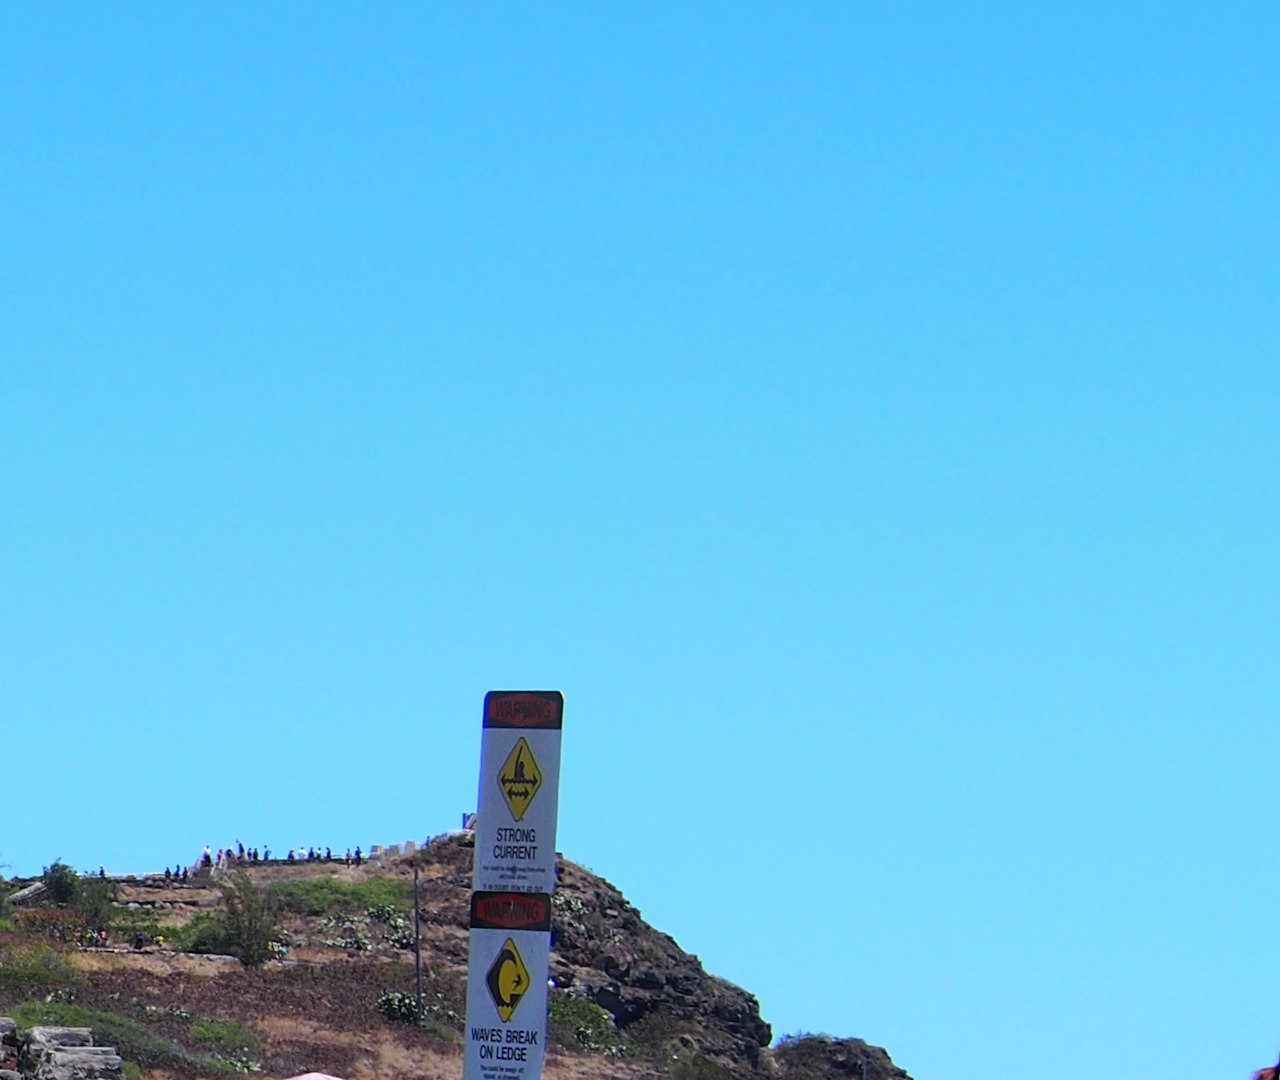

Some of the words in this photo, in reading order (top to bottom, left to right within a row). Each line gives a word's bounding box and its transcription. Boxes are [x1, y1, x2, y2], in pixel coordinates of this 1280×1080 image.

[496, 828, 536, 842] STRONG
[493, 845, 538, 860] CURRENT
[471, 1027, 502, 1043] WAVES
[506, 1030, 538, 1045] BREAK
[480, 1045, 493, 1059] ON
[496, 1046, 527, 1061] LEDGE
